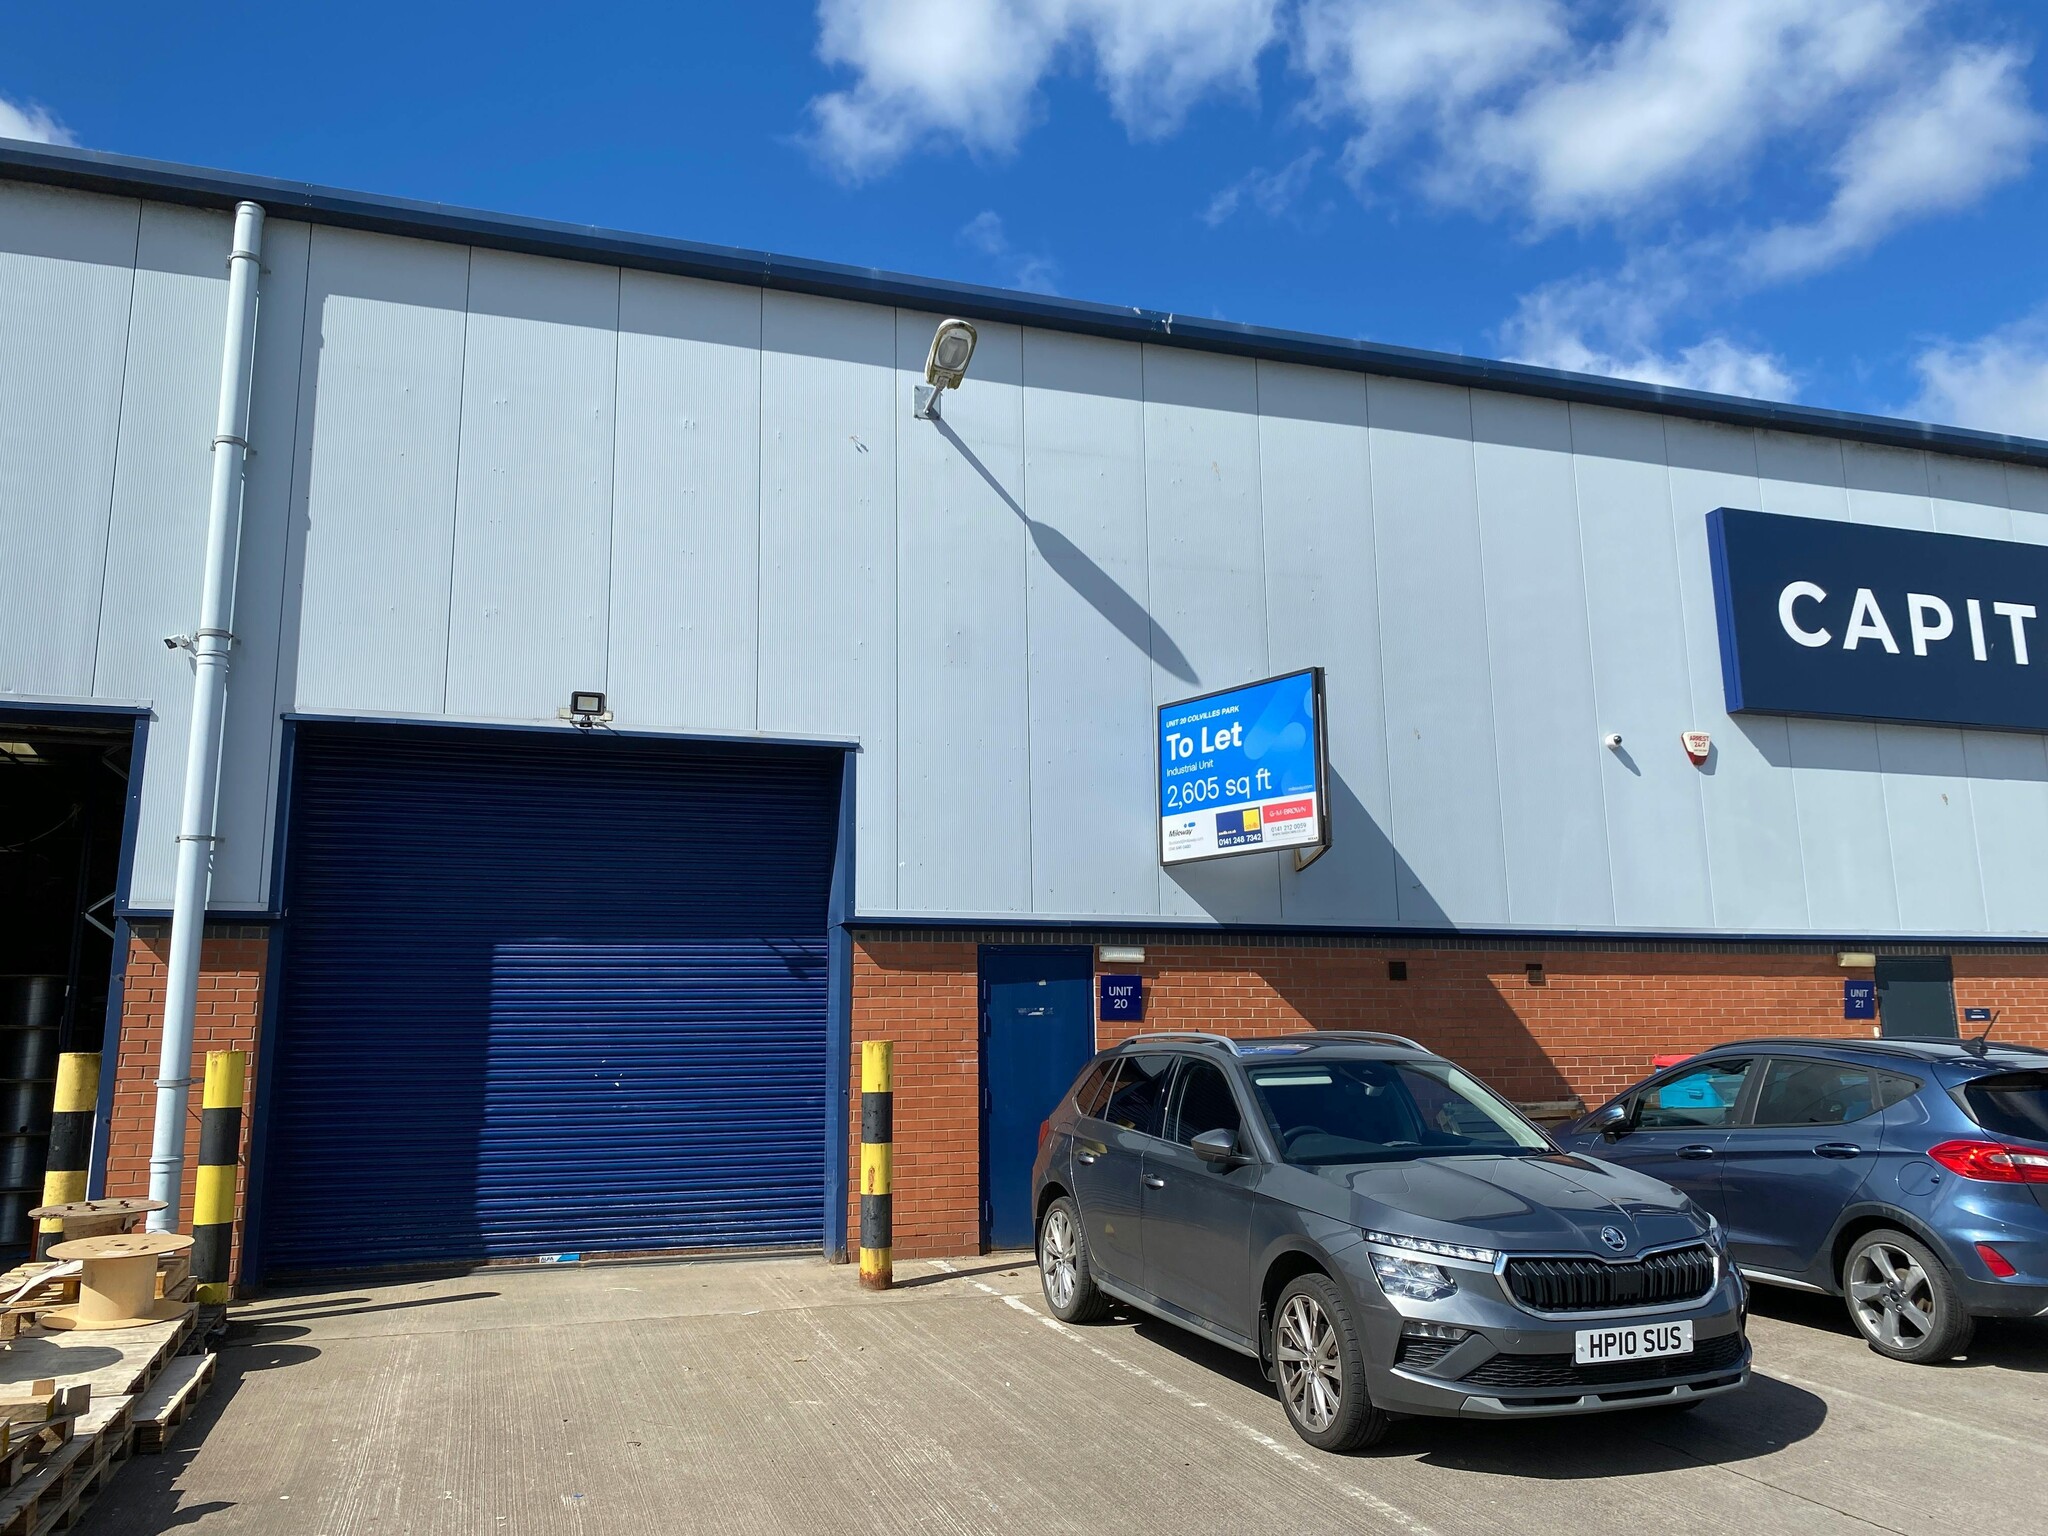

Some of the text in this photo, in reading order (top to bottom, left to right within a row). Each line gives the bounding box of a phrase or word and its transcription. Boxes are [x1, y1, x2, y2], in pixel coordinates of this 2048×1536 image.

[1778, 580, 2037, 665] CAPIT
[1166, 705, 1240, 728] UNIT 20 COLVILLES PARK
[1166, 721, 1243, 761] To Let
[1166, 759, 1214, 777] Industrial Unit
[1167, 767, 1272, 809] 2,605 sq ft
[1168, 829, 1193, 838] Mileway
[1218, 833, 1262, 846] 0141 248 7342
[1108, 986, 1133, 996] UNIT
[1850, 989, 1869, 998] UNIT
[1113, 998, 1128, 1009] 20
[1855, 999, 1864, 1008] 21
[1590, 1326, 1681, 1358] HP10 SUS
